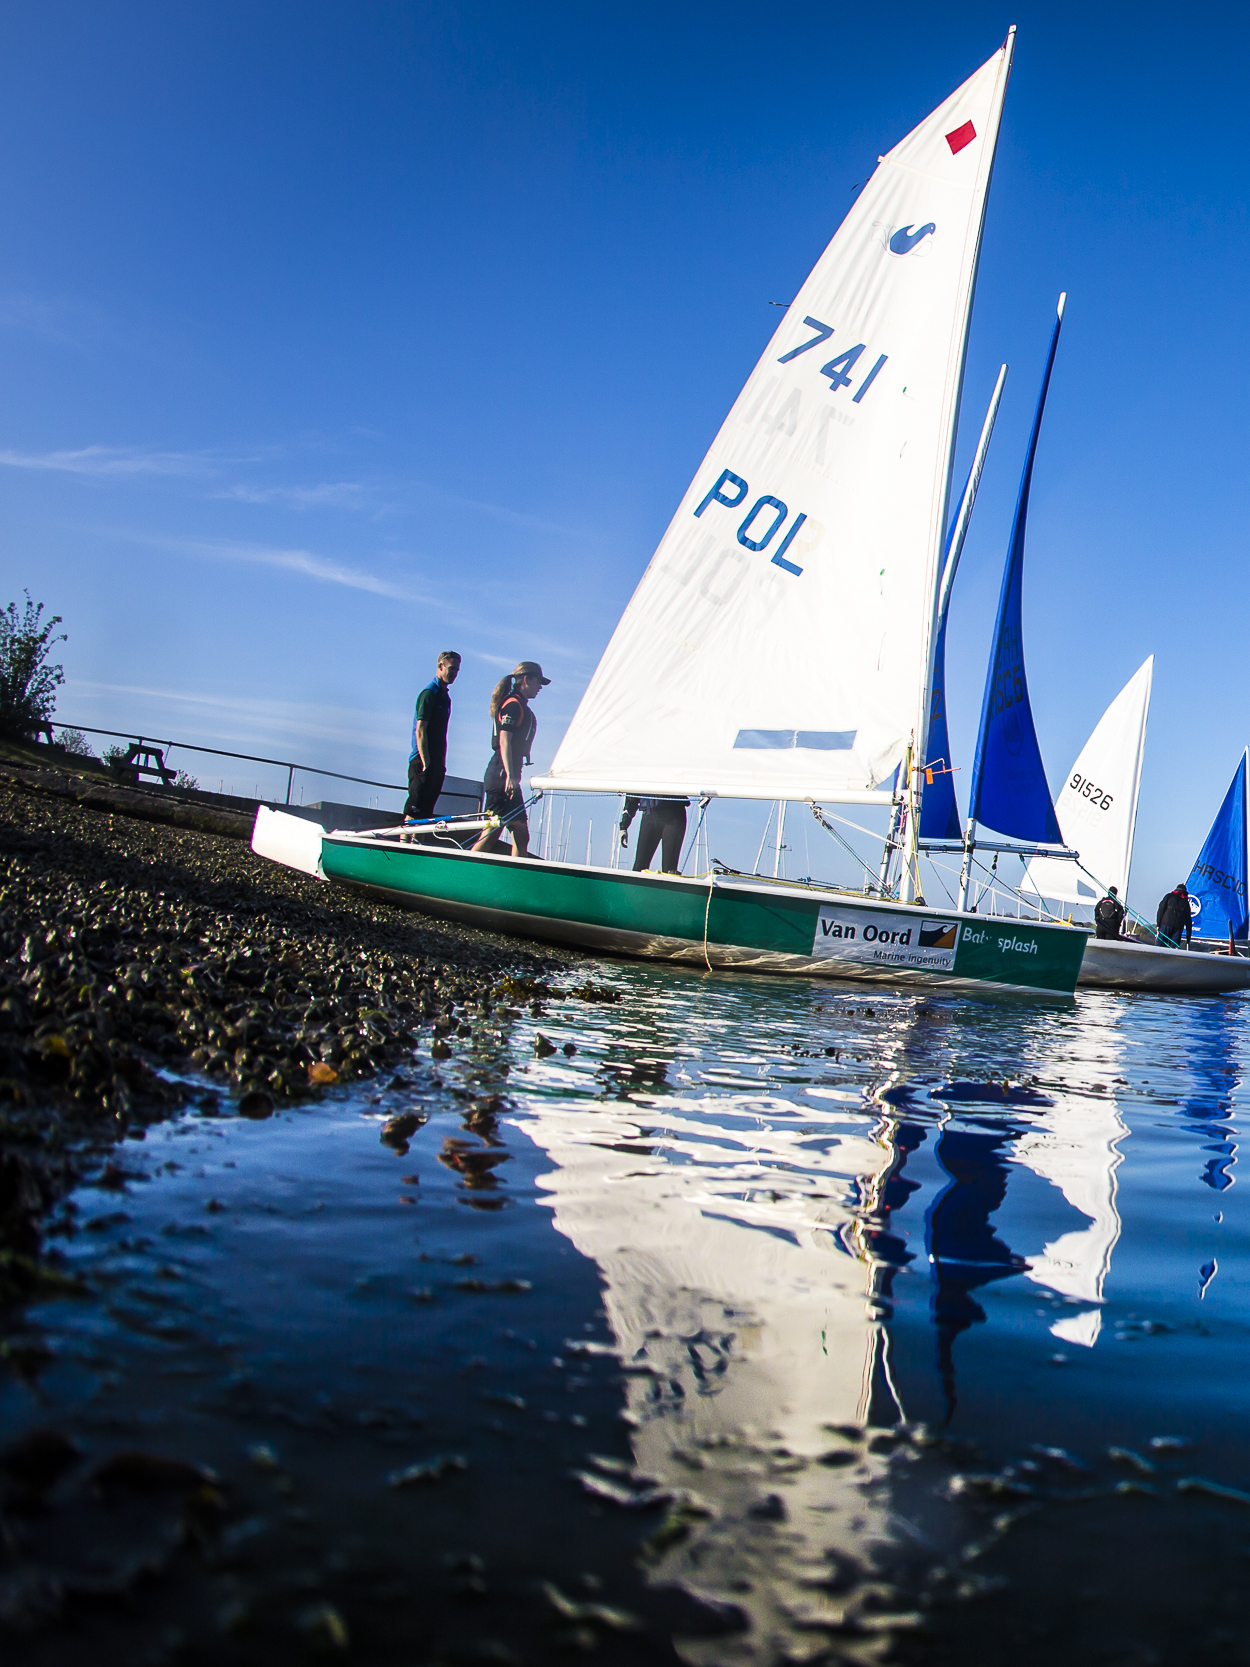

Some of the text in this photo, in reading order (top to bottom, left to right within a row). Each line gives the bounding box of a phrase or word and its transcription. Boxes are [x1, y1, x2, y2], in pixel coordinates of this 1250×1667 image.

[777, 316, 888, 403] 741
[693, 468, 807, 577] POL
[1069, 773, 1114, 811] 91526
[820, 918, 912, 945] Van Oord
[962, 926, 1038, 955] Bat splash
[873, 950, 951, 968] Marine ingenuity
